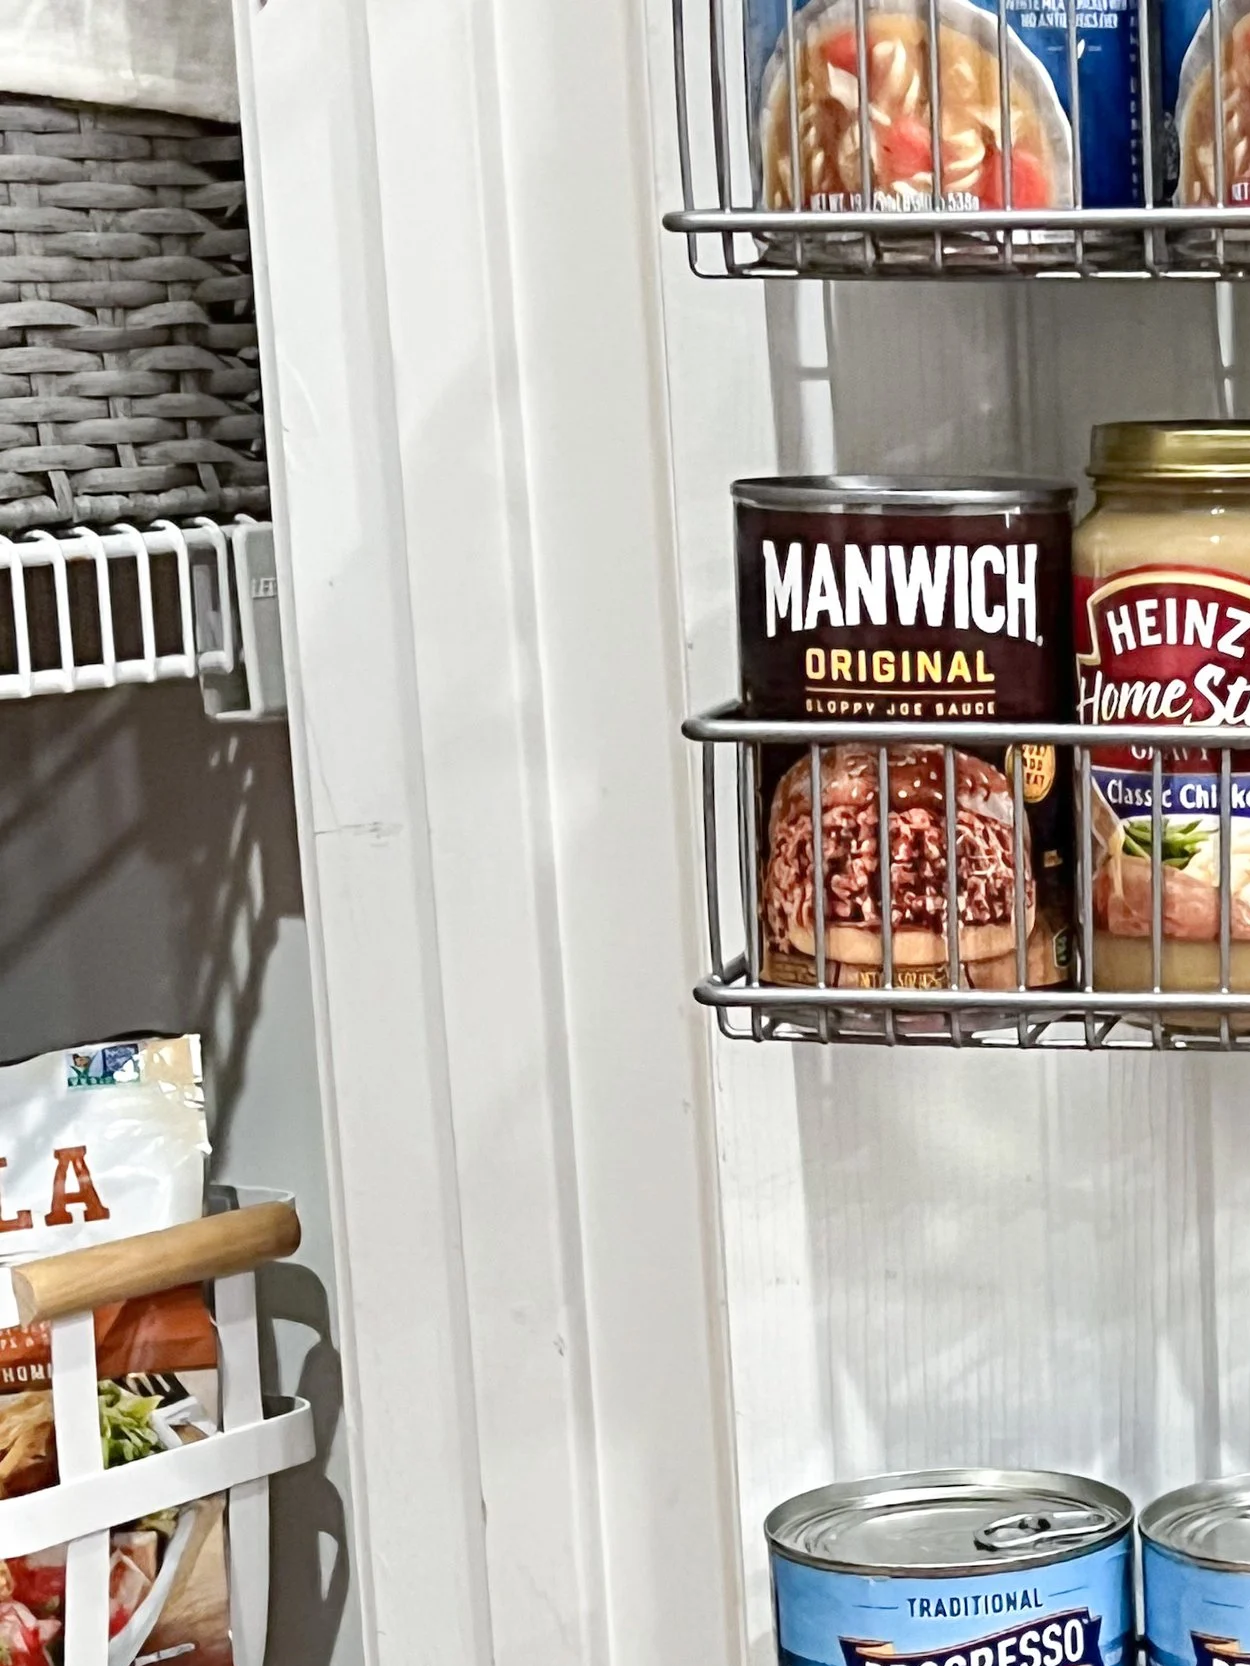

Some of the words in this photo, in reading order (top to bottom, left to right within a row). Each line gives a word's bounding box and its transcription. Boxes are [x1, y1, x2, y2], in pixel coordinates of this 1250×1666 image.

[762, 539, 1039, 644] MANWICH
[805, 647, 996, 684] ORIGINAL
[886, 700, 923, 716] JOE
[1107, 779, 1172, 808] Classc
[906, 1587, 1044, 1618] TRADITIONAL
